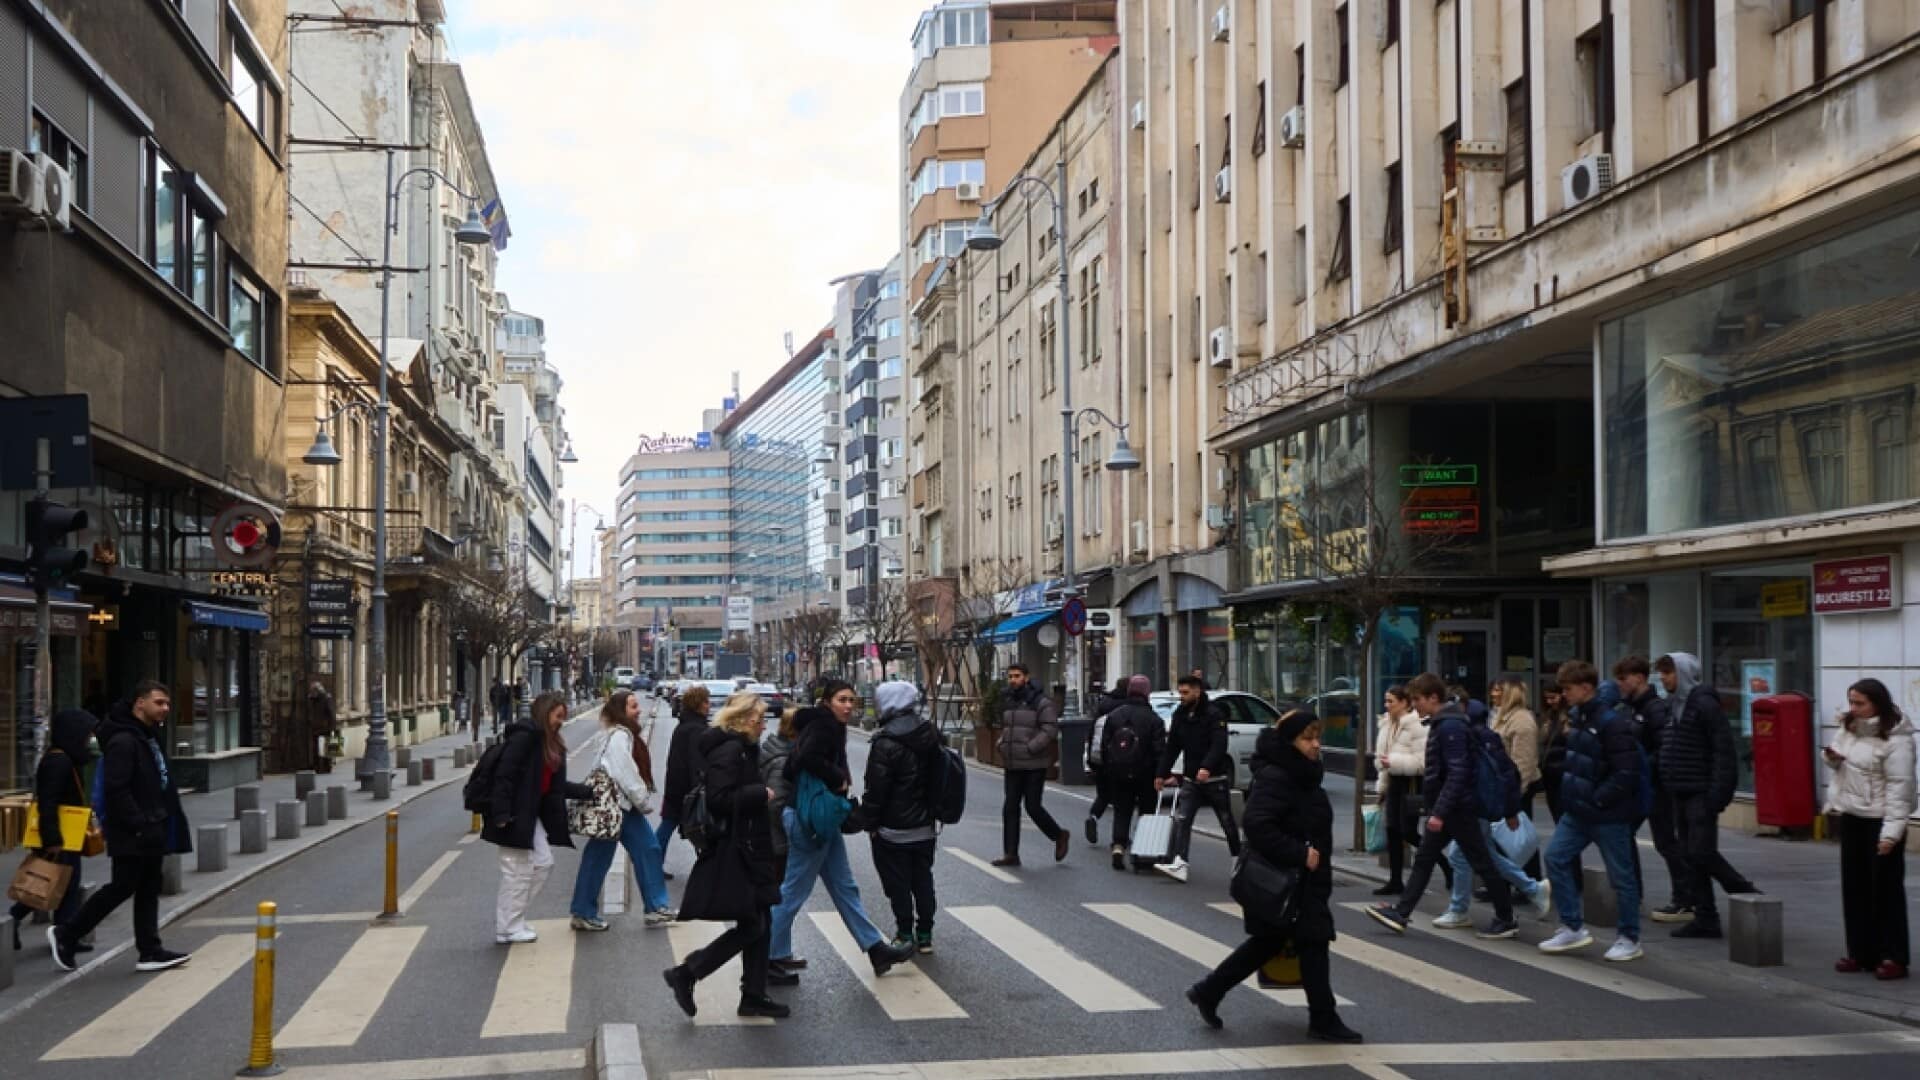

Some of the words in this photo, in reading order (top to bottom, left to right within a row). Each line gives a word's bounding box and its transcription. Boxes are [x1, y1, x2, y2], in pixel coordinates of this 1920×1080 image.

[1424, 470, 1458, 480] WANT
[211, 572, 278, 585] CENTRALE
[1877, 589, 1890, 601] 22
